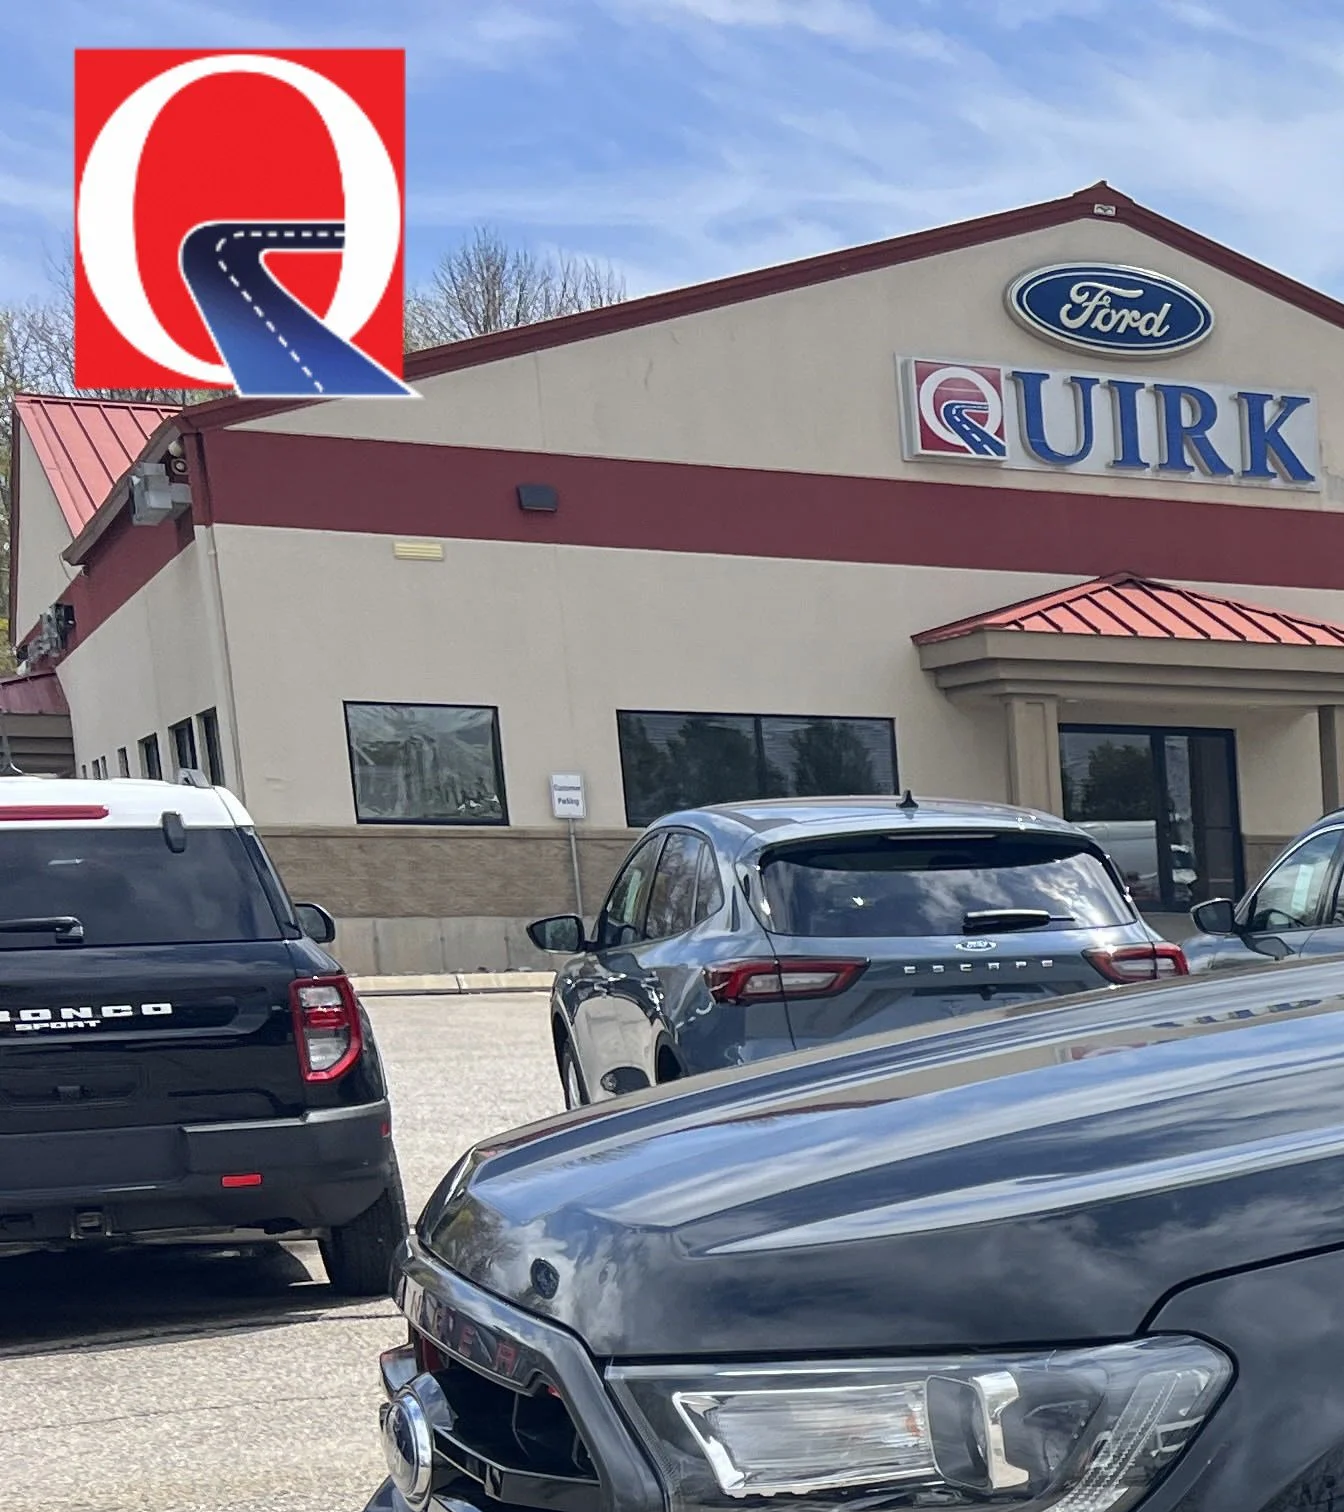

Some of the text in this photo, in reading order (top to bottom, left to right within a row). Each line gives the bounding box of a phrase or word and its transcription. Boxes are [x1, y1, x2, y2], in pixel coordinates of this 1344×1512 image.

[1059, 281, 1171, 338] Ford
[904, 959, 1053, 974] ESCAPE
[15, 1020, 100, 1031] SPORT
